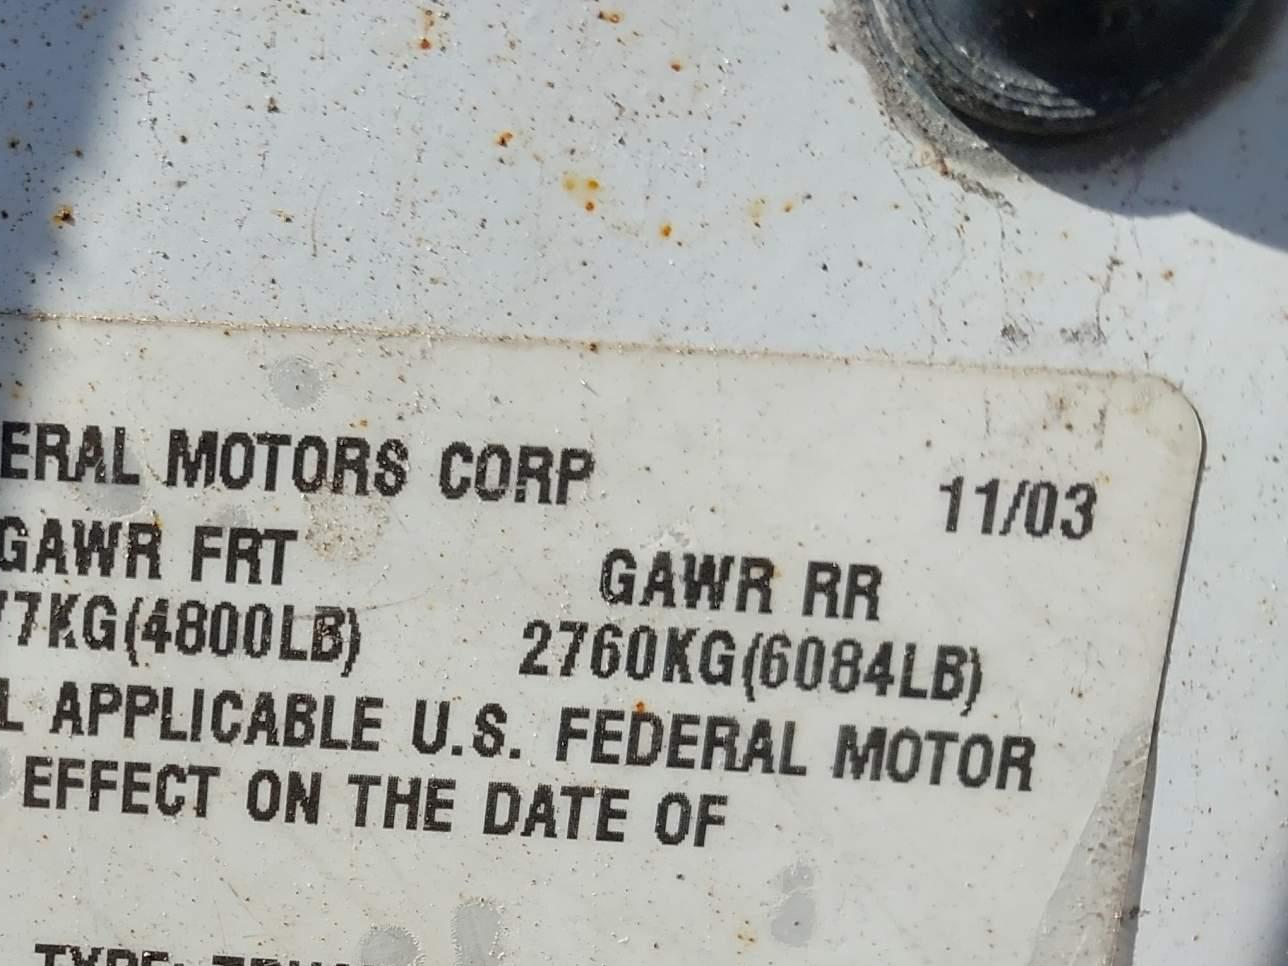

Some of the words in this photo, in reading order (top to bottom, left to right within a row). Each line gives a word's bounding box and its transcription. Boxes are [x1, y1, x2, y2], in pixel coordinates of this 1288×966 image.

[167, 428, 409, 497] MOTORS
[438, 441, 596, 505] CORP
[940, 475, 1100, 540] 11/03
[191, 525, 298, 586] FRT
[600, 548, 774, 614] GAWR
[803, 560, 883, 621] RR
[518, 620, 984, 715] 2760KG(6084LB)
[51, 681, 383, 752] APPLICABLE
[413, 699, 521, 759] U.S.
[554, 708, 807, 778] FEDERAL
[832, 724, 1037, 791] MOTOR
[23, 756, 221, 818] EFFECT
[246, 768, 321, 825] ON
[348, 771, 456, 833] THE
[482, 781, 630, 842] DATE
[654, 792, 728, 848] OF
